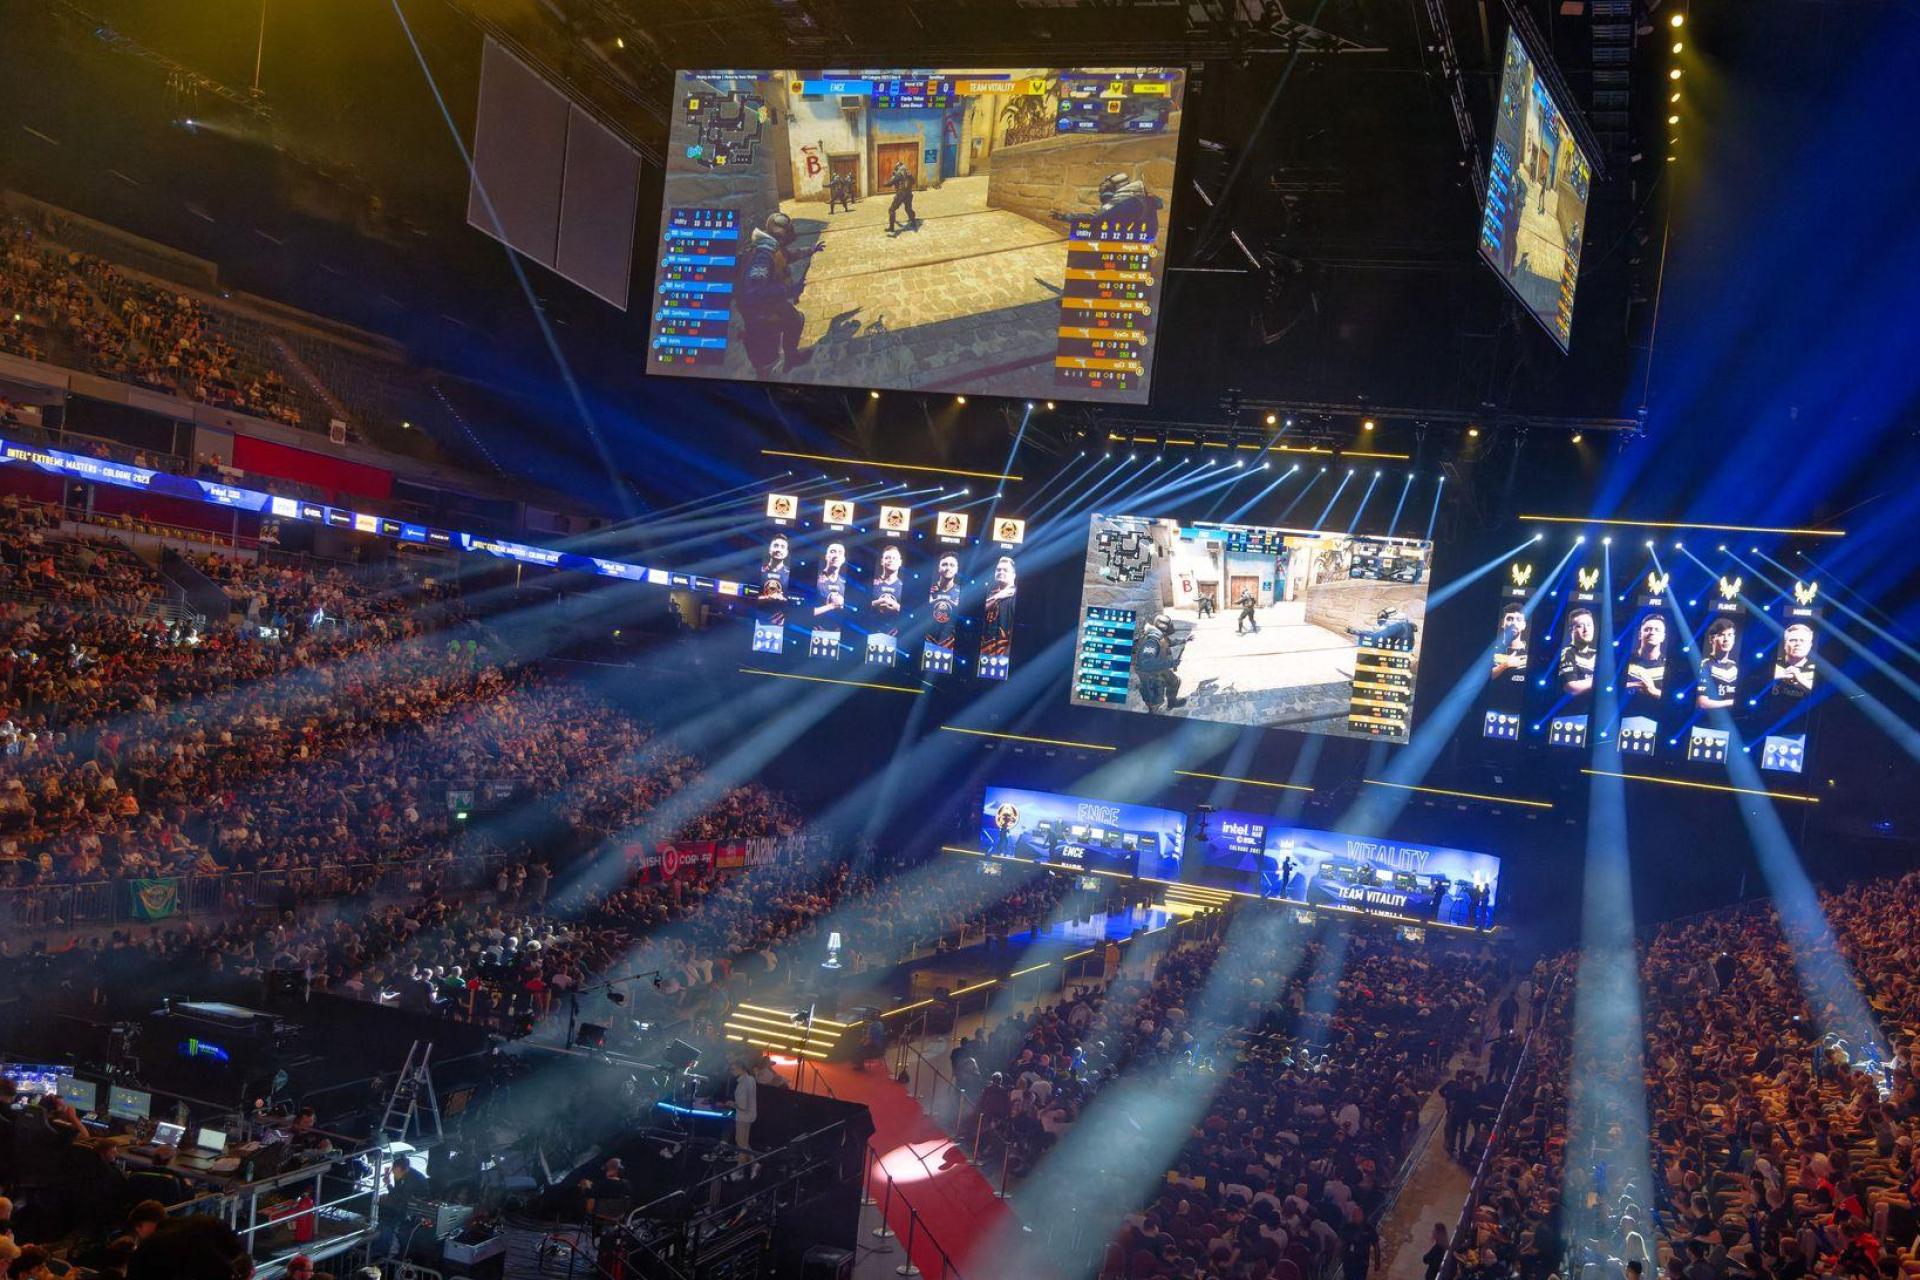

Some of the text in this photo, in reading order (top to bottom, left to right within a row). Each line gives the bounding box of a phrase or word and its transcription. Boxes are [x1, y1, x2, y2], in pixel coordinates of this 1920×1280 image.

[878, 82, 885, 93] 0
[943, 82, 949, 93] 0
[969, 82, 1015, 92] TEAM VITALITY
[806, 155, 822, 177] B
[32, 453, 64, 467] EXTREME
[66, 459, 97, 473] MASTERS
[102, 467, 131, 481] COLOGNE
[132, 473, 150, 484] 2023
[1183, 580, 1192, 593] B
[1078, 803, 1120, 827] ENCE
[1222, 821, 1250, 836] intel
[1062, 845, 1086, 858] ENCE
[1347, 840, 1430, 873] VITALITY
[1338, 887, 1407, 907] TEAM VITALITY
